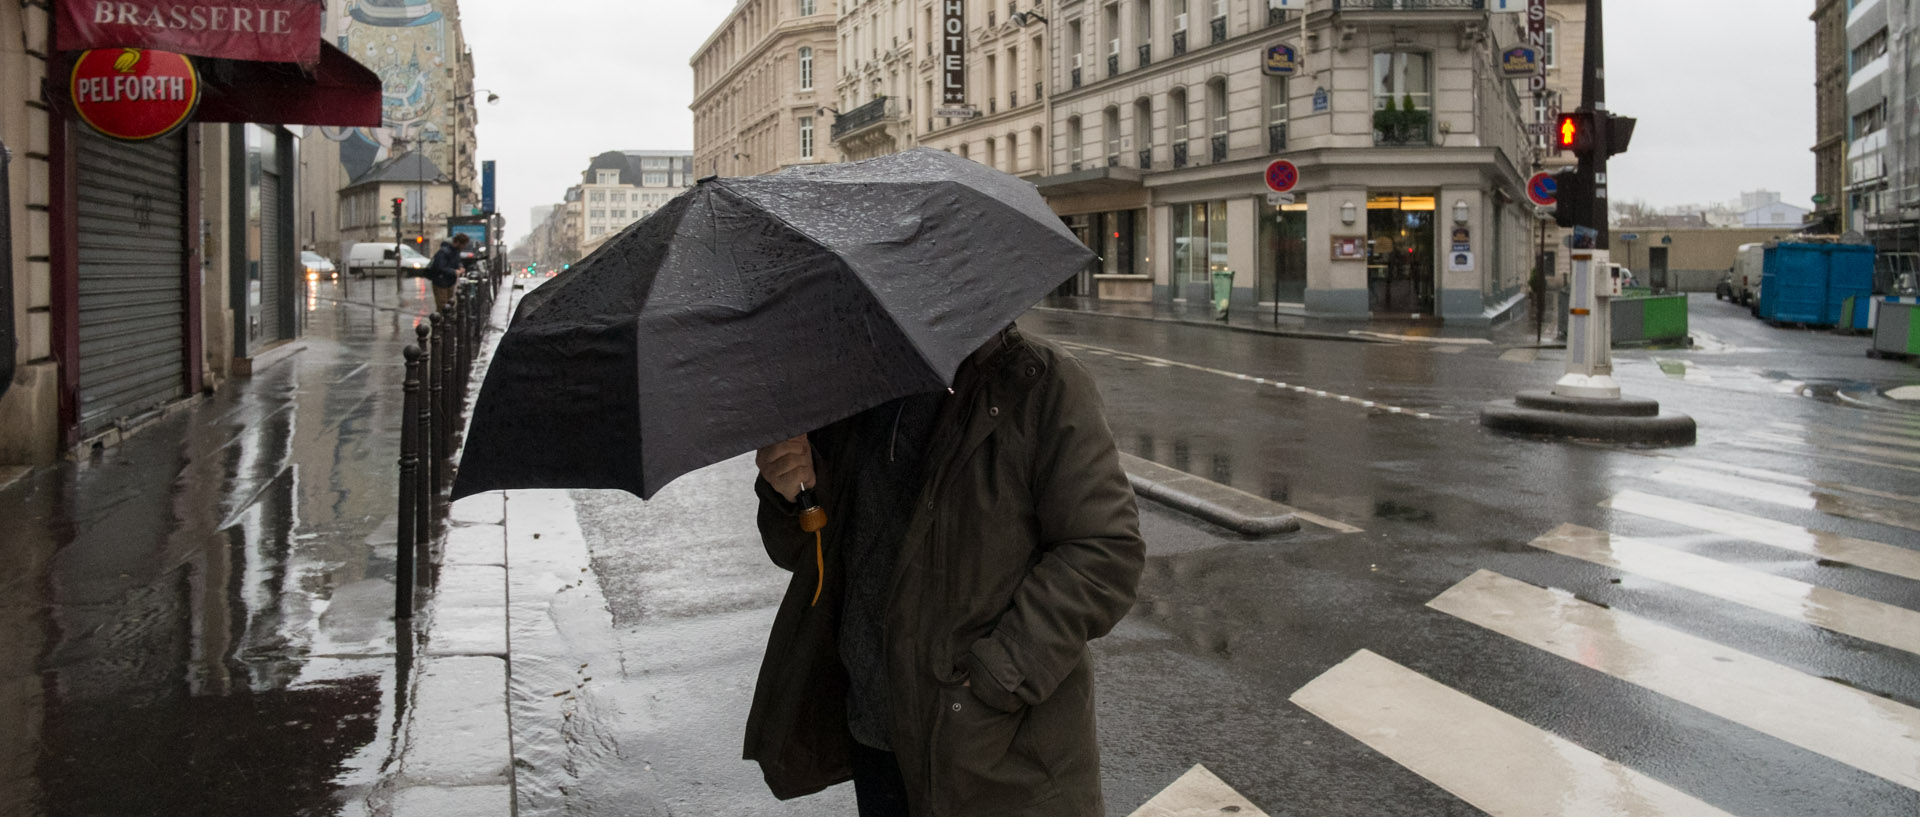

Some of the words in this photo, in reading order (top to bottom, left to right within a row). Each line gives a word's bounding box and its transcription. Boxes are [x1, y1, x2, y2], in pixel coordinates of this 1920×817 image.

[93, 1, 292, 34] BRASSERIE
[946, 0, 962, 88] HOTEL
[78, 75, 185, 103] PELFORTH
